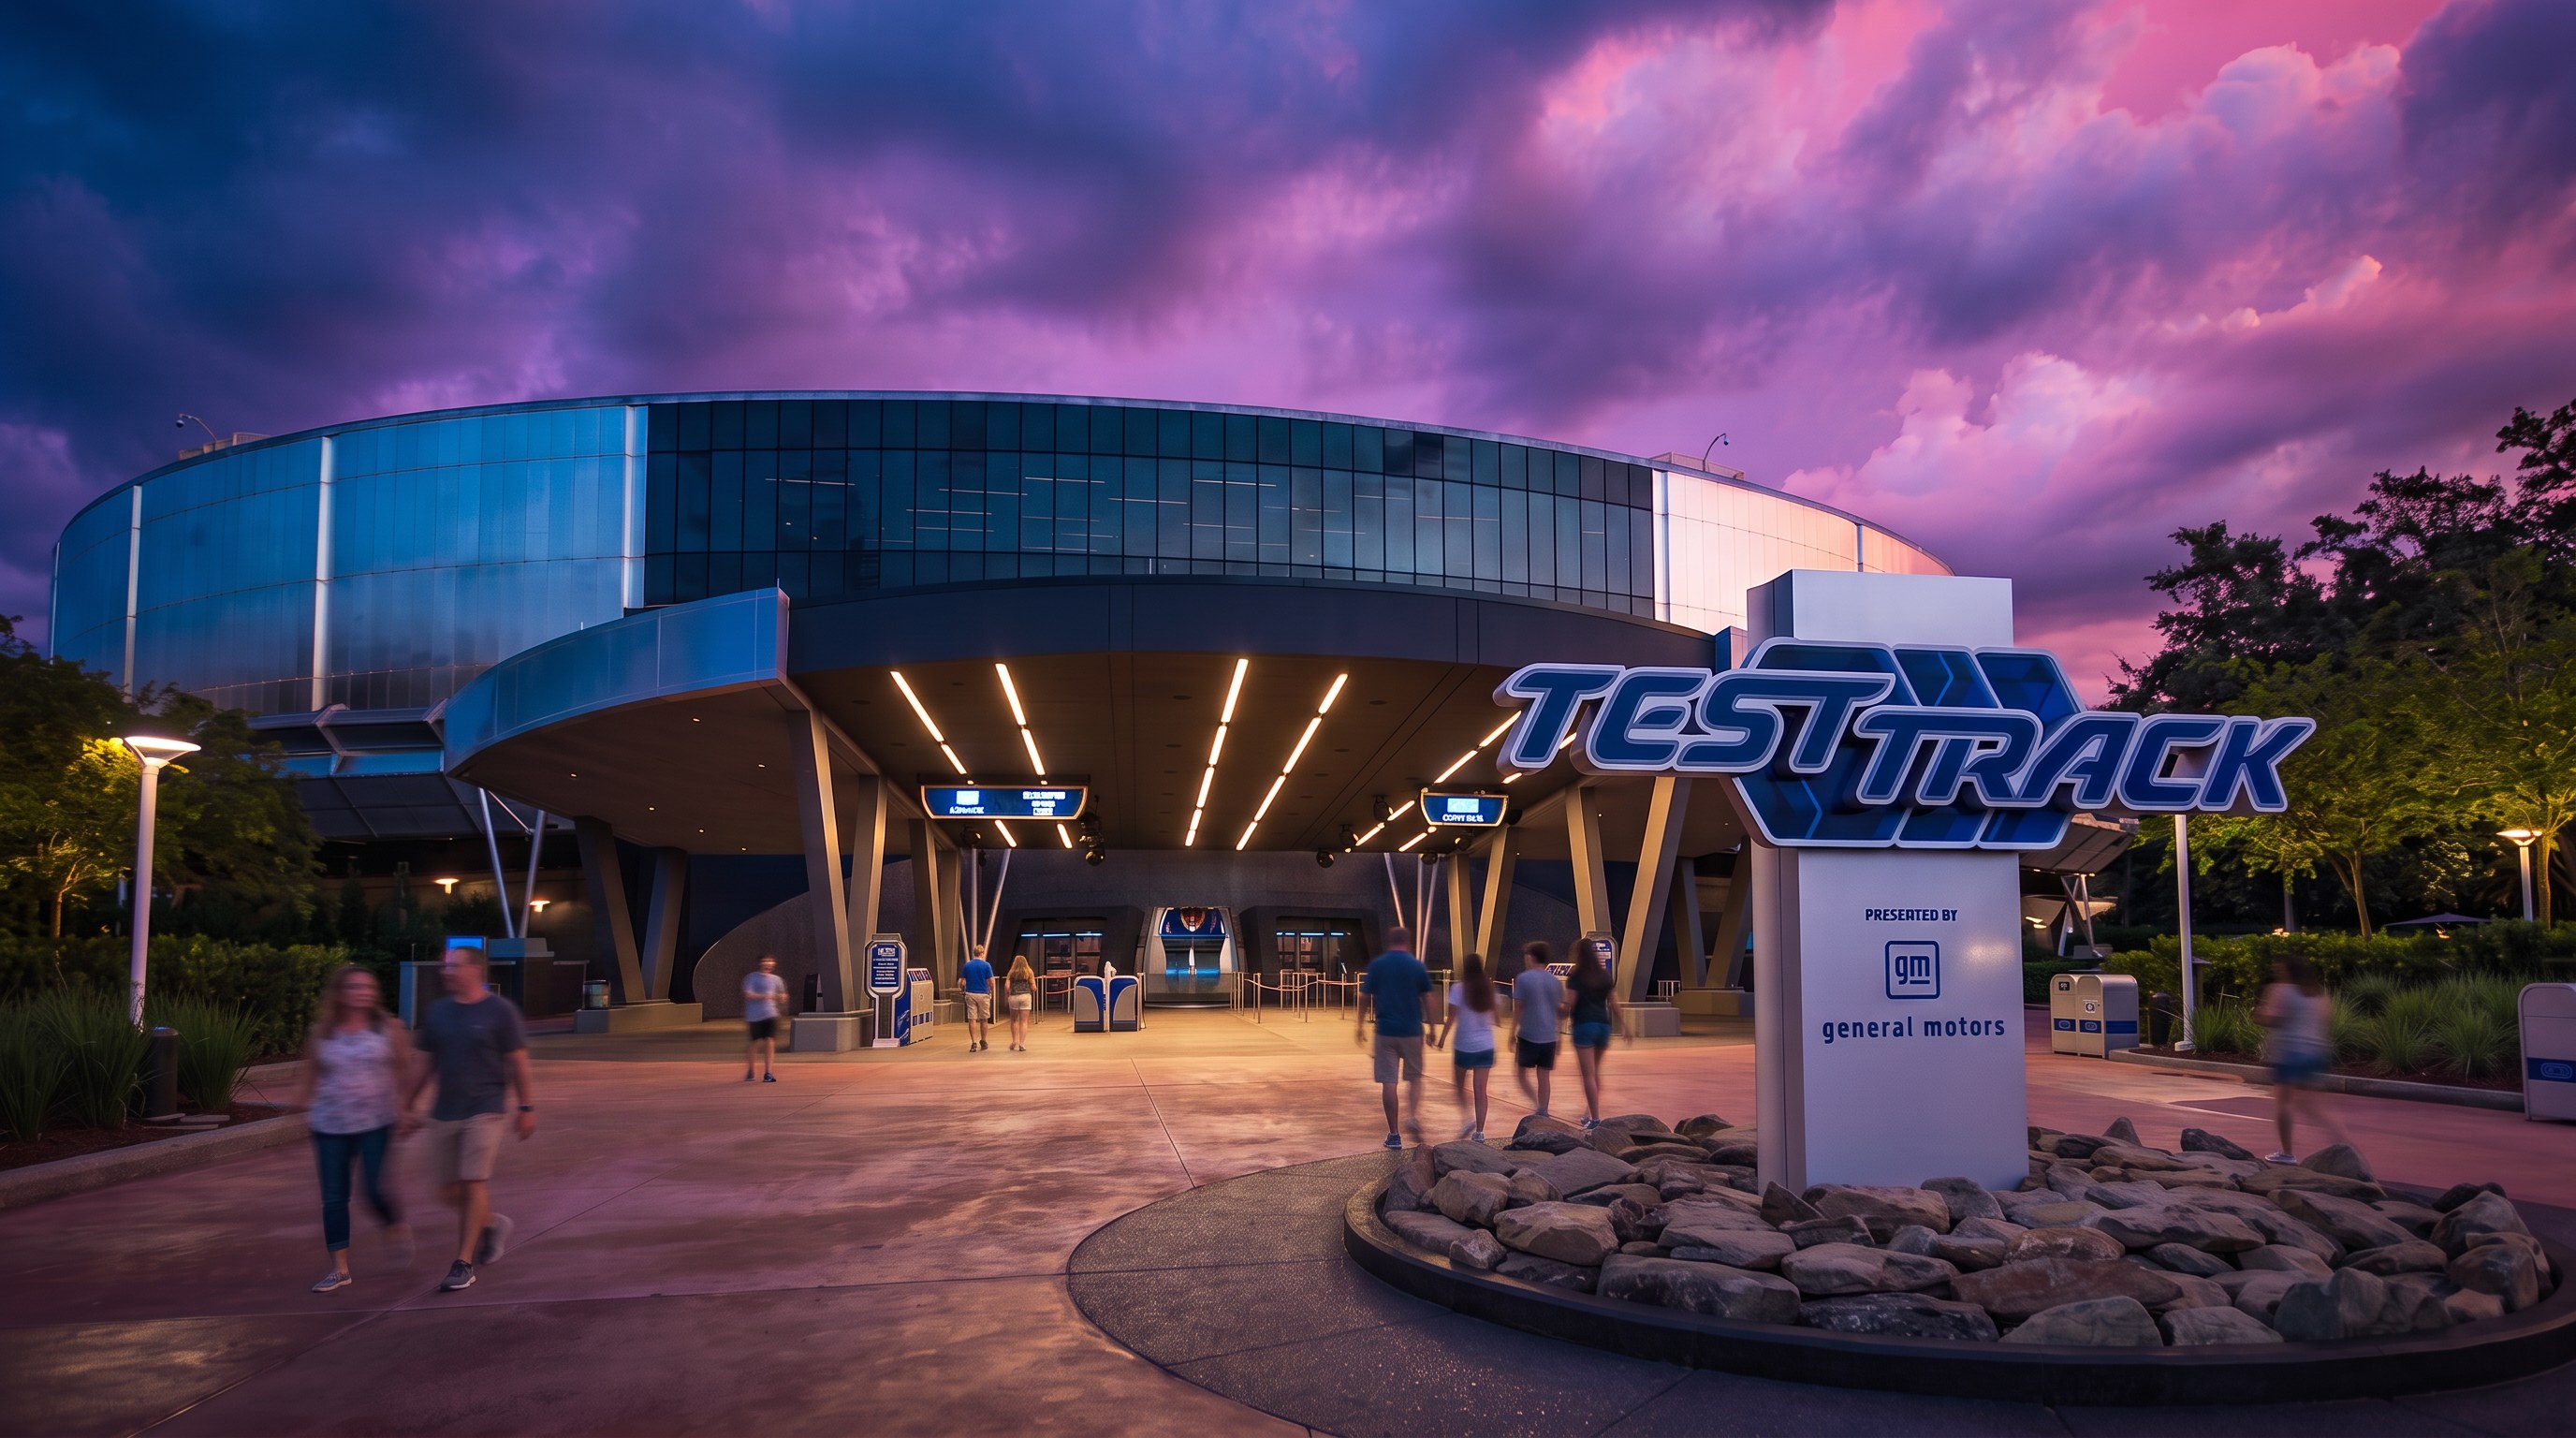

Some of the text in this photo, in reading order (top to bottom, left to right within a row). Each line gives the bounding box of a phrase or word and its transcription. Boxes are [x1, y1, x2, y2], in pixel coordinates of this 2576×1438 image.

[1503, 663, 2317, 813] TEST TRACK
[1942, 909, 1958, 921] BY
[1895, 955, 1930, 985] gm
[1822, 1016, 2005, 1044] general motors
